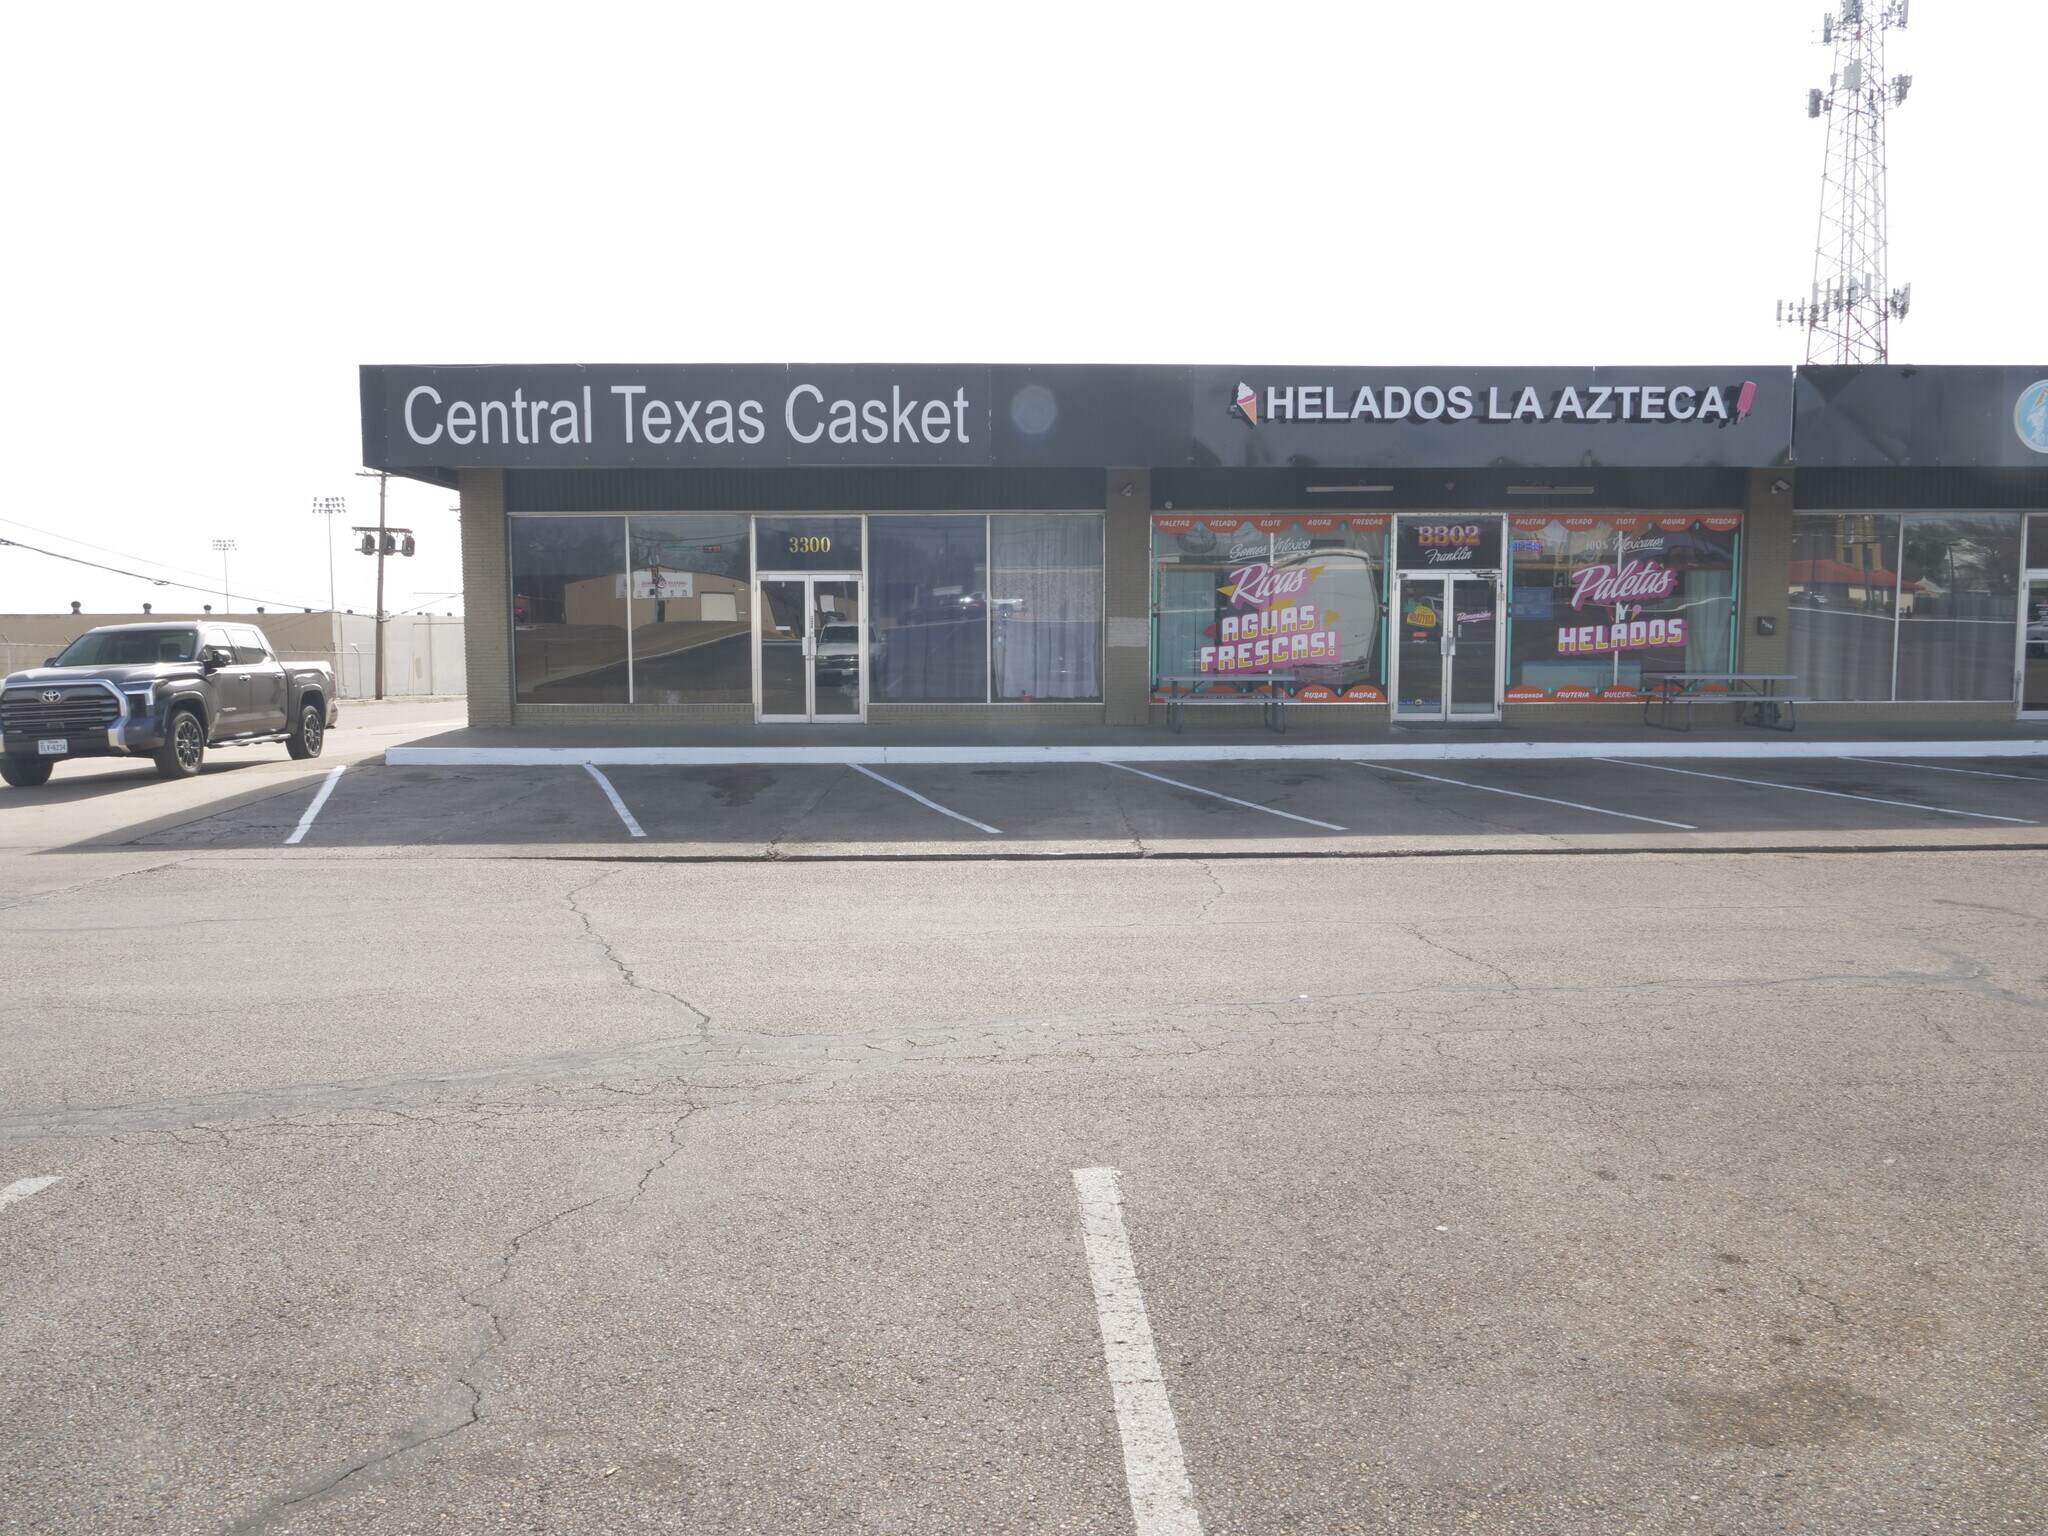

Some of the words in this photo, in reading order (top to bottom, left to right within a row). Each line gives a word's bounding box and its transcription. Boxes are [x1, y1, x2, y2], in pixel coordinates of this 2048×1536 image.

[404, 385, 592, 445] Central
[611, 385, 765, 445] Texas
[785, 384, 970, 445] Casket
[1267, 386, 1473, 420] HELADOS
[1489, 387, 1544, 420] LA
[1553, 386, 1728, 420] AZTECA
[1159, 519, 1191, 527] PALETAS
[1210, 519, 1237, 527] HELADO
[1261, 519, 1281, 527] ELOTE
[1352, 518, 1384, 526] FRESCAS
[1418, 525, 1481, 546] 3302
[789, 536, 831, 553] 3300
[1229, 543, 1267, 559] Somos
[1425, 546, 1473, 564] Franklin
[1586, 540, 1609, 551] 100%
[1610, 537, 1664, 552] Mexicanos
[1229, 563, 1307, 604] Ricas
[1572, 559, 1673, 608] Paletas
[1222, 605, 1315, 642] AGUAS
[1558, 619, 1683, 652] HELADOS
[1200, 631, 1336, 672] FRESCAS!
